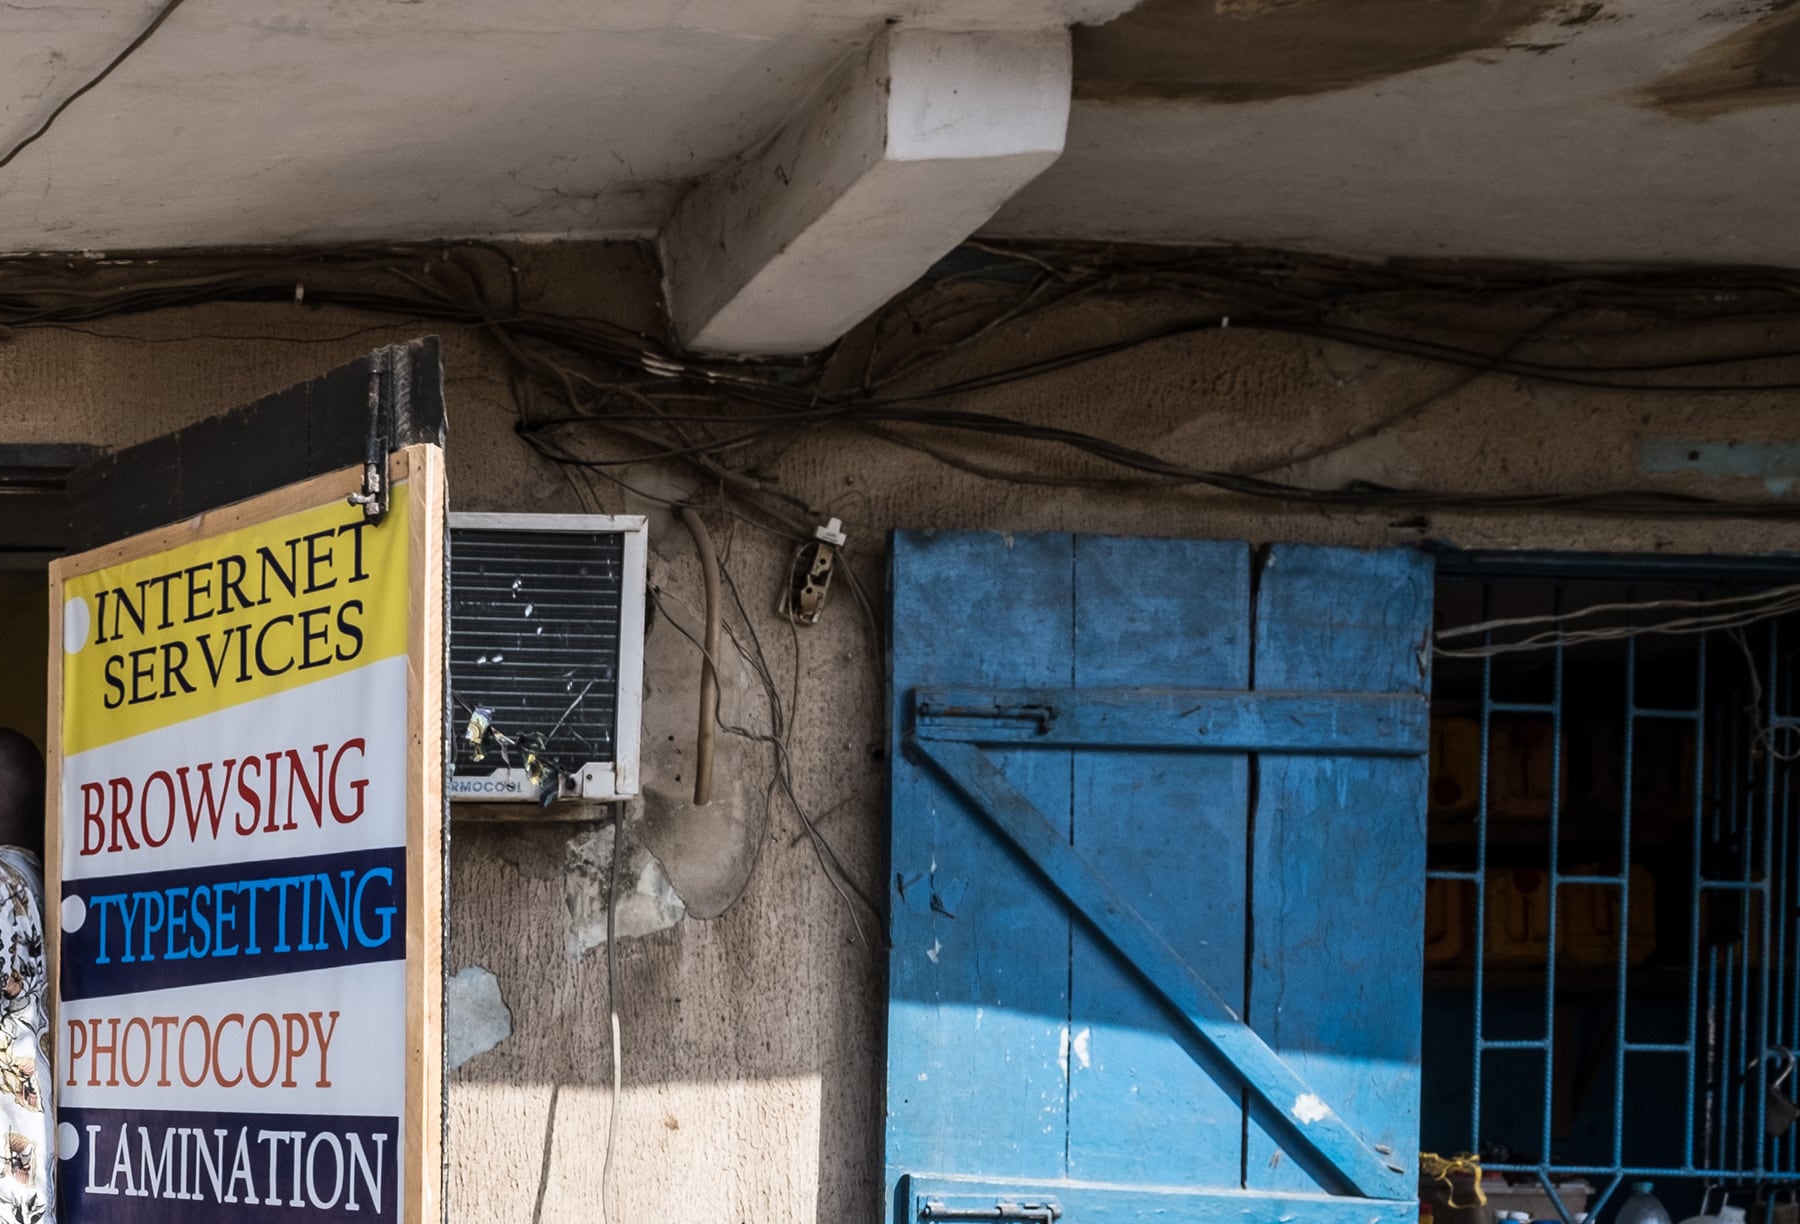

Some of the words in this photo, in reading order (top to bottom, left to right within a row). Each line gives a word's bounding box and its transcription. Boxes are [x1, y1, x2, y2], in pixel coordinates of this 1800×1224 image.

[94, 519, 369, 645] INTERNET
[104, 599, 364, 710] SERVICES
[80, 737, 370, 857] BROWSING
[448, 781, 522, 793] RMOCOOL
[89, 867, 397, 965] TYPESETTING
[66, 1010, 340, 1089] PHOTOCOPY
[84, 1122, 388, 1215] LAMINATION
